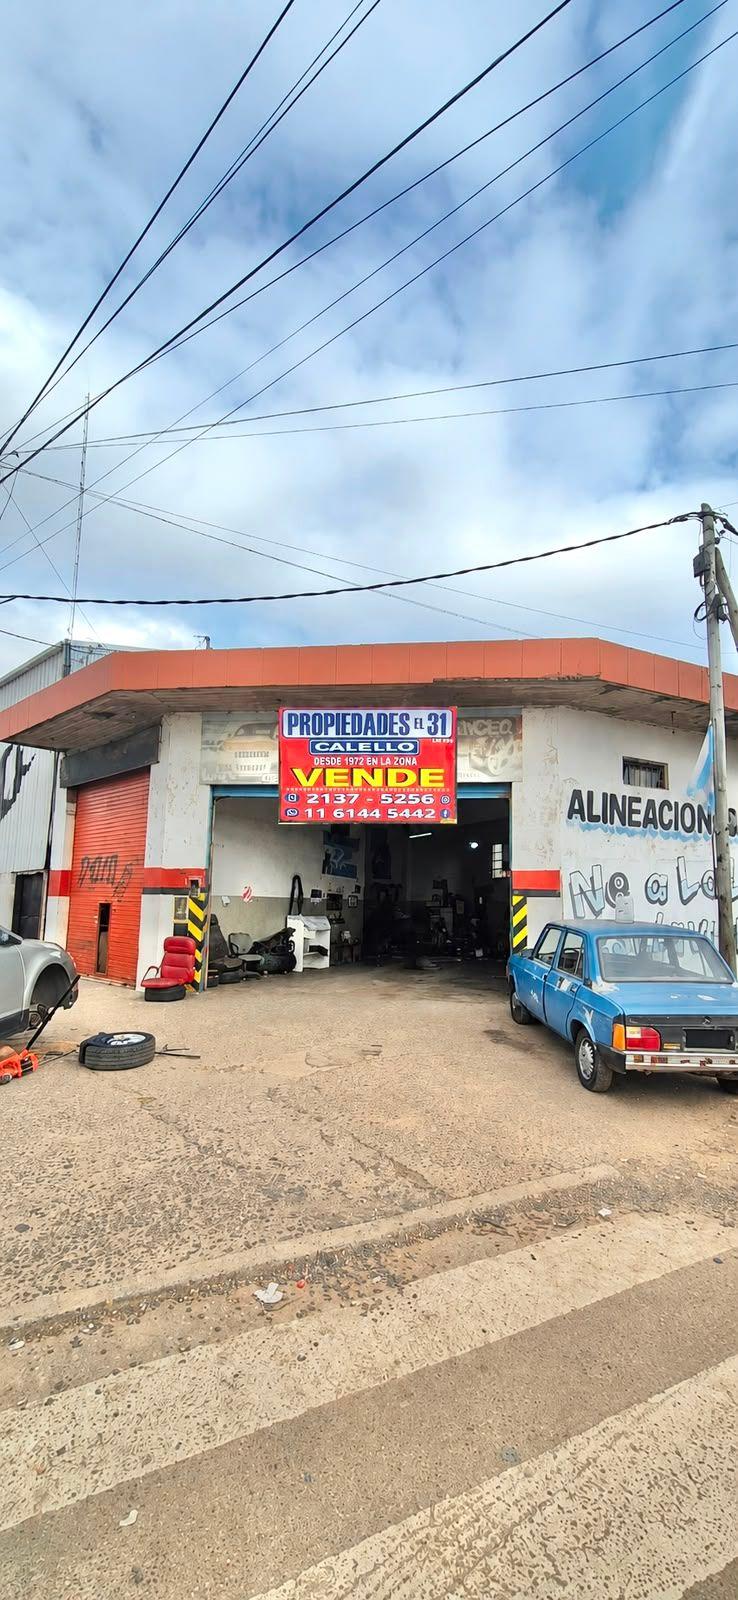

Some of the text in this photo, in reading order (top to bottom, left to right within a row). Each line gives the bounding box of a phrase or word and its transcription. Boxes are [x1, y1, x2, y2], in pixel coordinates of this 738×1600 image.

[287, 712, 447, 736] PROPIEDADES EL 31
[314, 741, 415, 752] CALELLO
[314, 756, 418, 766] DESDE 1972 EN LA ZONA
[291, 767, 445, 788] VENDE
[306, 793, 361, 804] 2137
[380, 793, 435, 804] 5256
[304, 808, 436, 819] 11 6144 5442
[567, 788, 714, 836] ALINEACION
